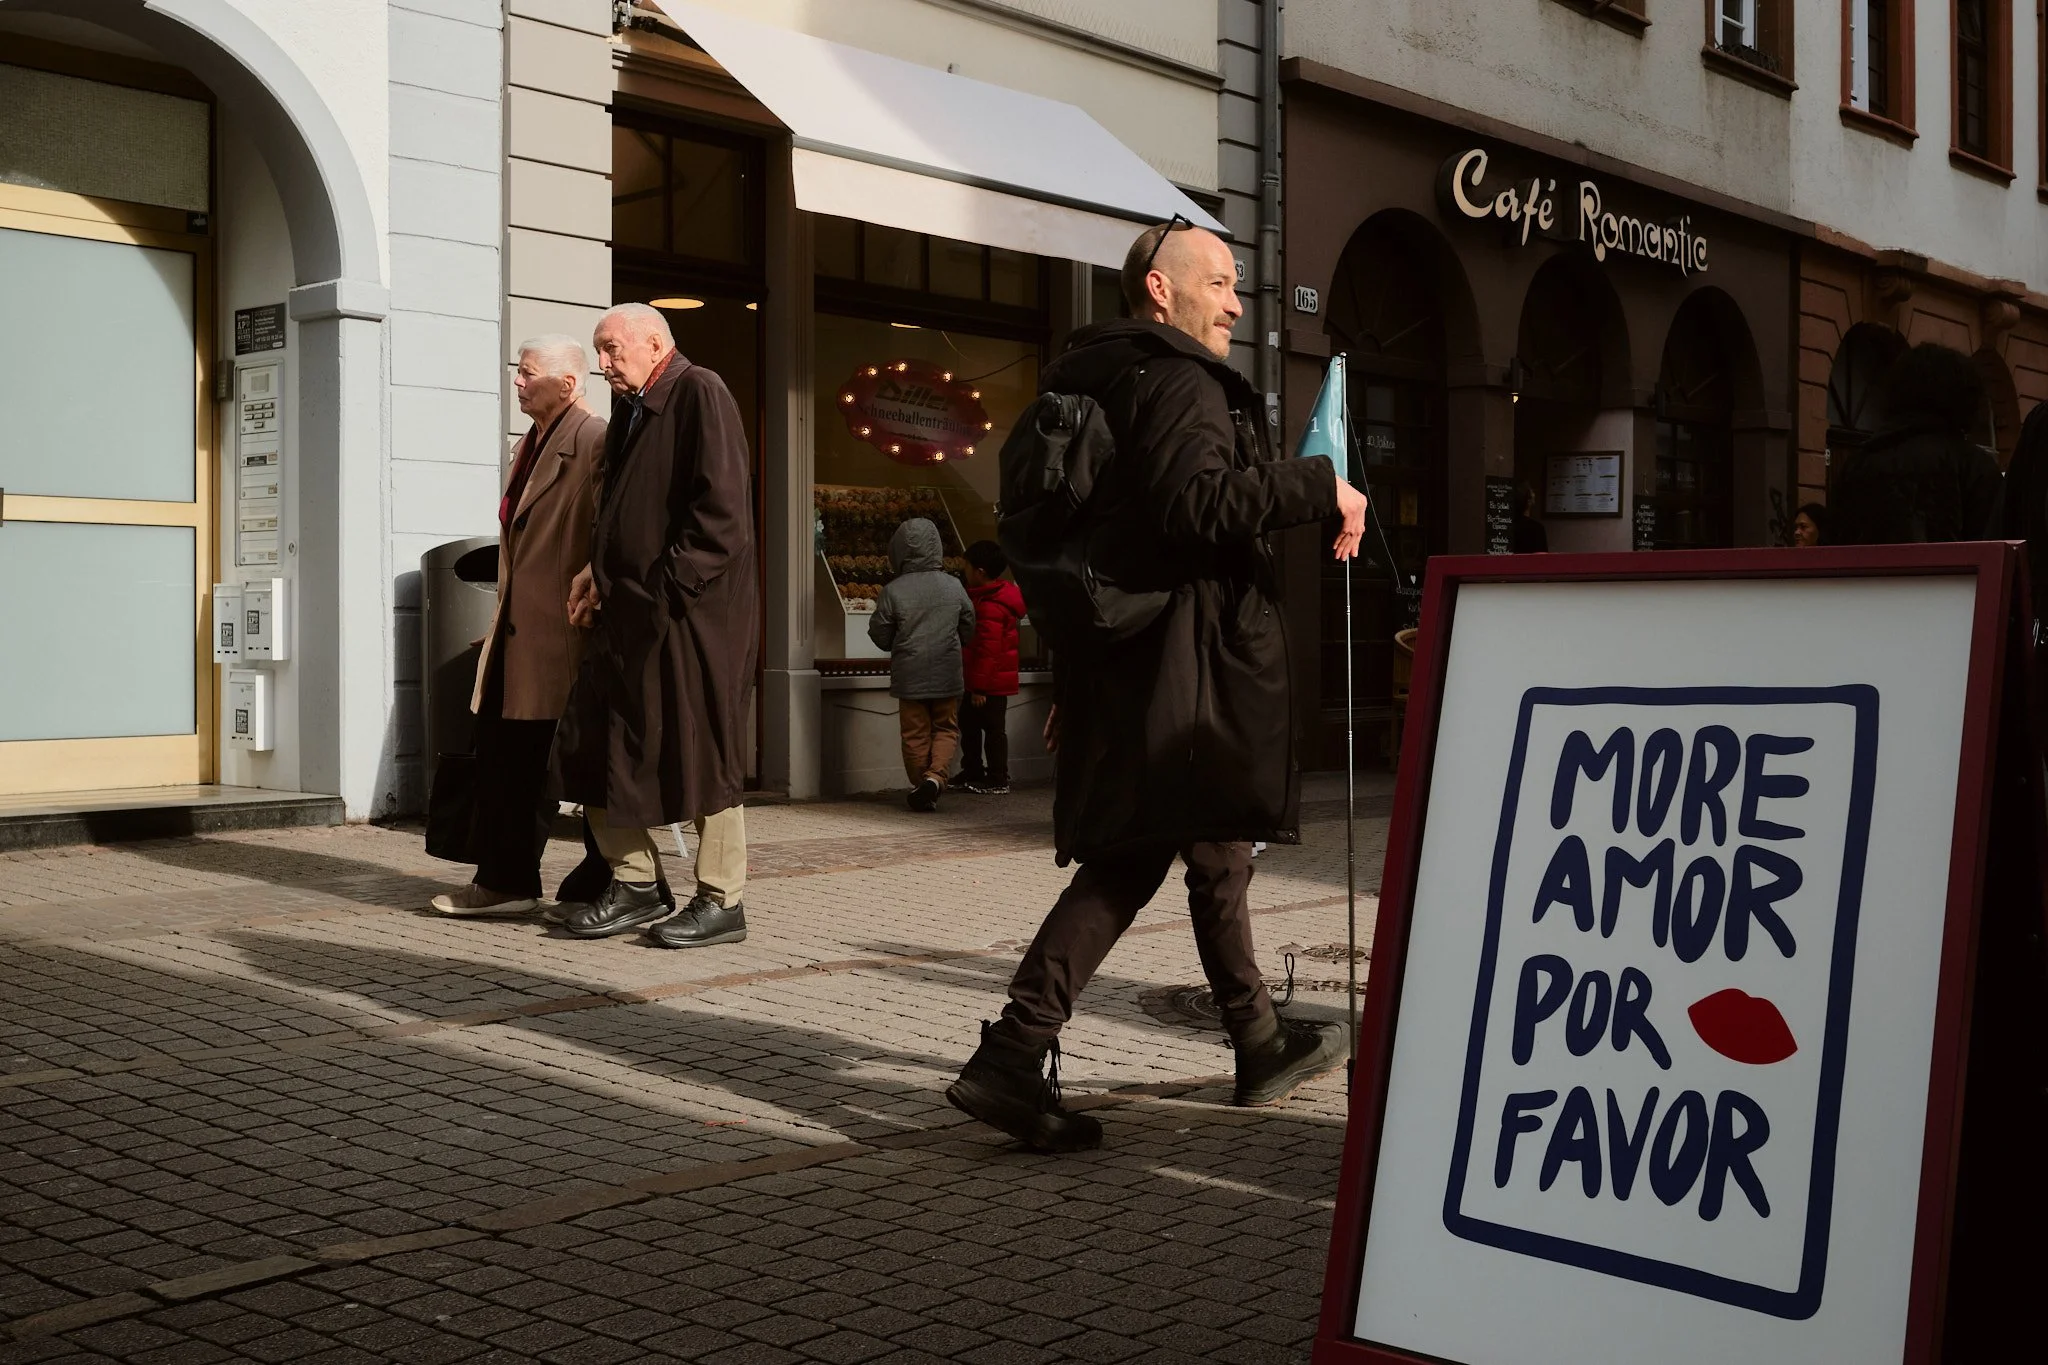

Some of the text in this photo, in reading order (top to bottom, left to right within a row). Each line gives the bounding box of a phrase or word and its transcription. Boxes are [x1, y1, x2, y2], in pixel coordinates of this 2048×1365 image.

[1453, 148, 1708, 278] Café Romantic
[1297, 288, 1316, 310] 165
[1310, 416, 1320, 433] 1
[1551, 725, 1814, 846] MORE
[1532, 835, 1803, 963] AMOR
[1512, 954, 1672, 1069] POR
[1494, 1086, 1770, 1221] FAVOR
